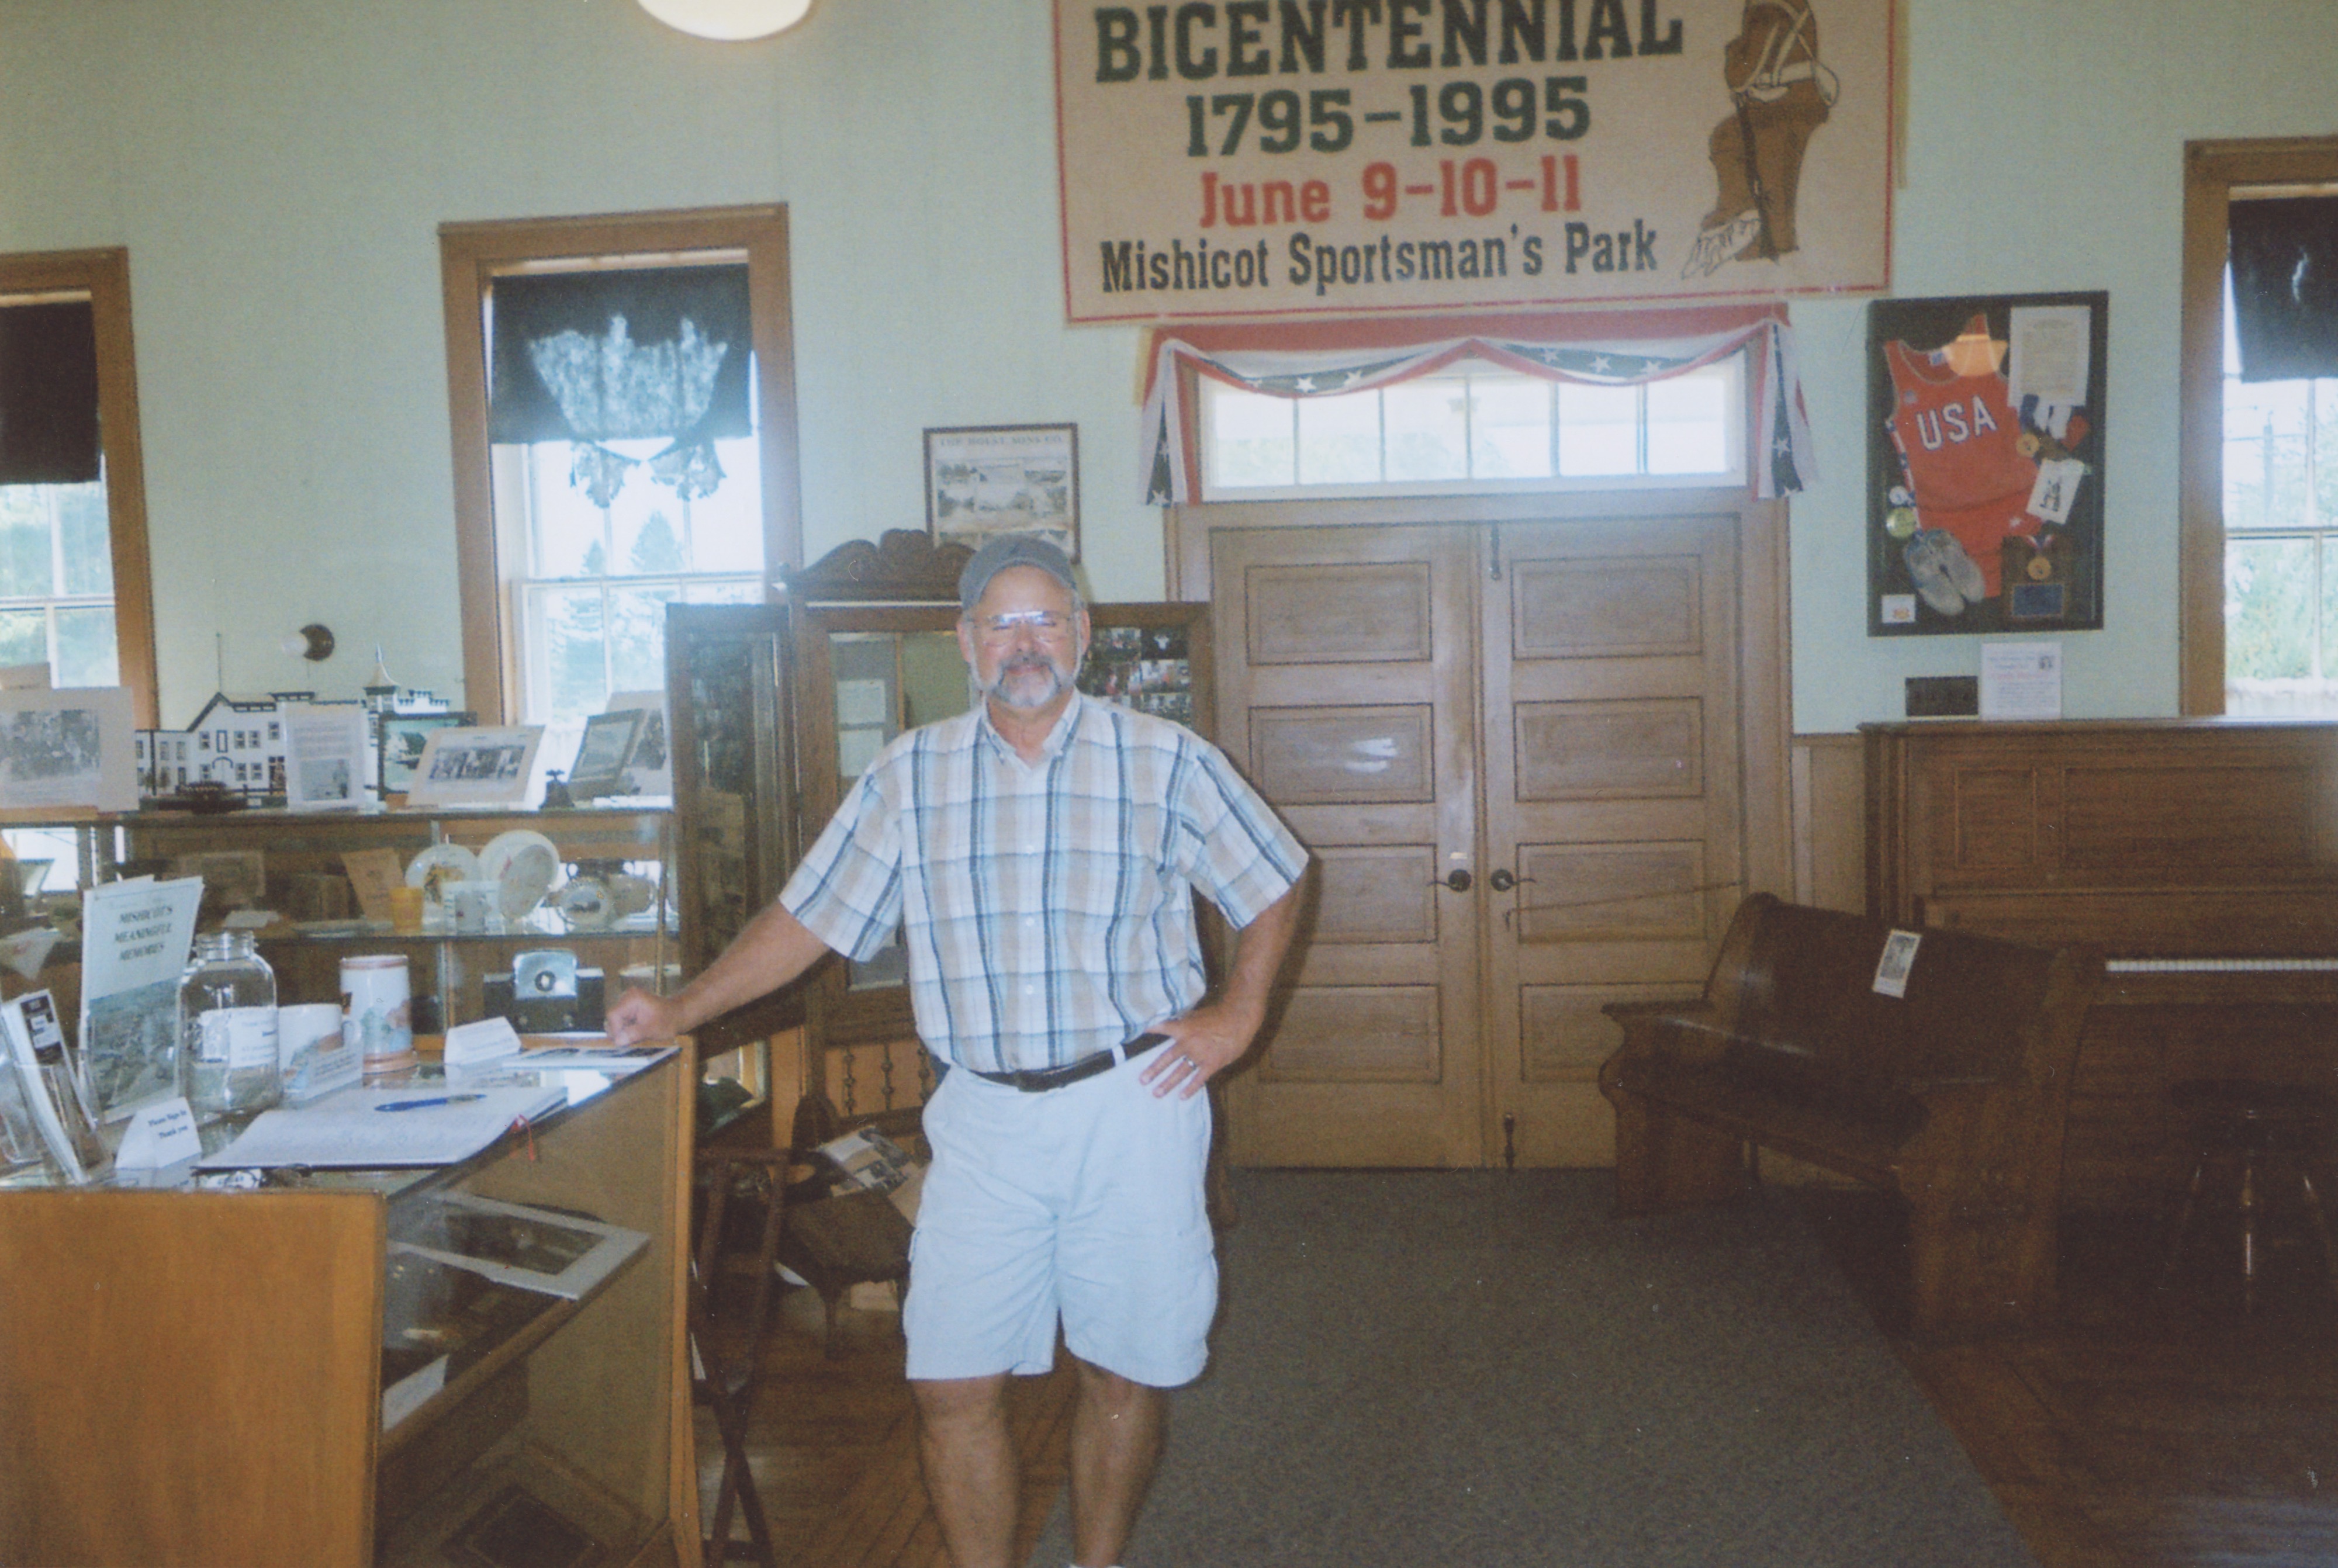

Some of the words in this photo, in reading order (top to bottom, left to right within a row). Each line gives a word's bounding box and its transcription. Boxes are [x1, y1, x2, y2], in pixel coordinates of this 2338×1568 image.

[1094, 0, 1684, 83] BICENTENNIAL
[1185, 75, 1591, 157] 1795-1995
[1199, 171, 1330, 228] June
[1362, 154, 1581, 221] 9-10-11
[1100, 239, 1270, 292] Mishicot
[1288, 223, 1544, 296] Sportsman's
[1564, 219, 1657, 274] Park
[1915, 394, 1998, 451] USA
